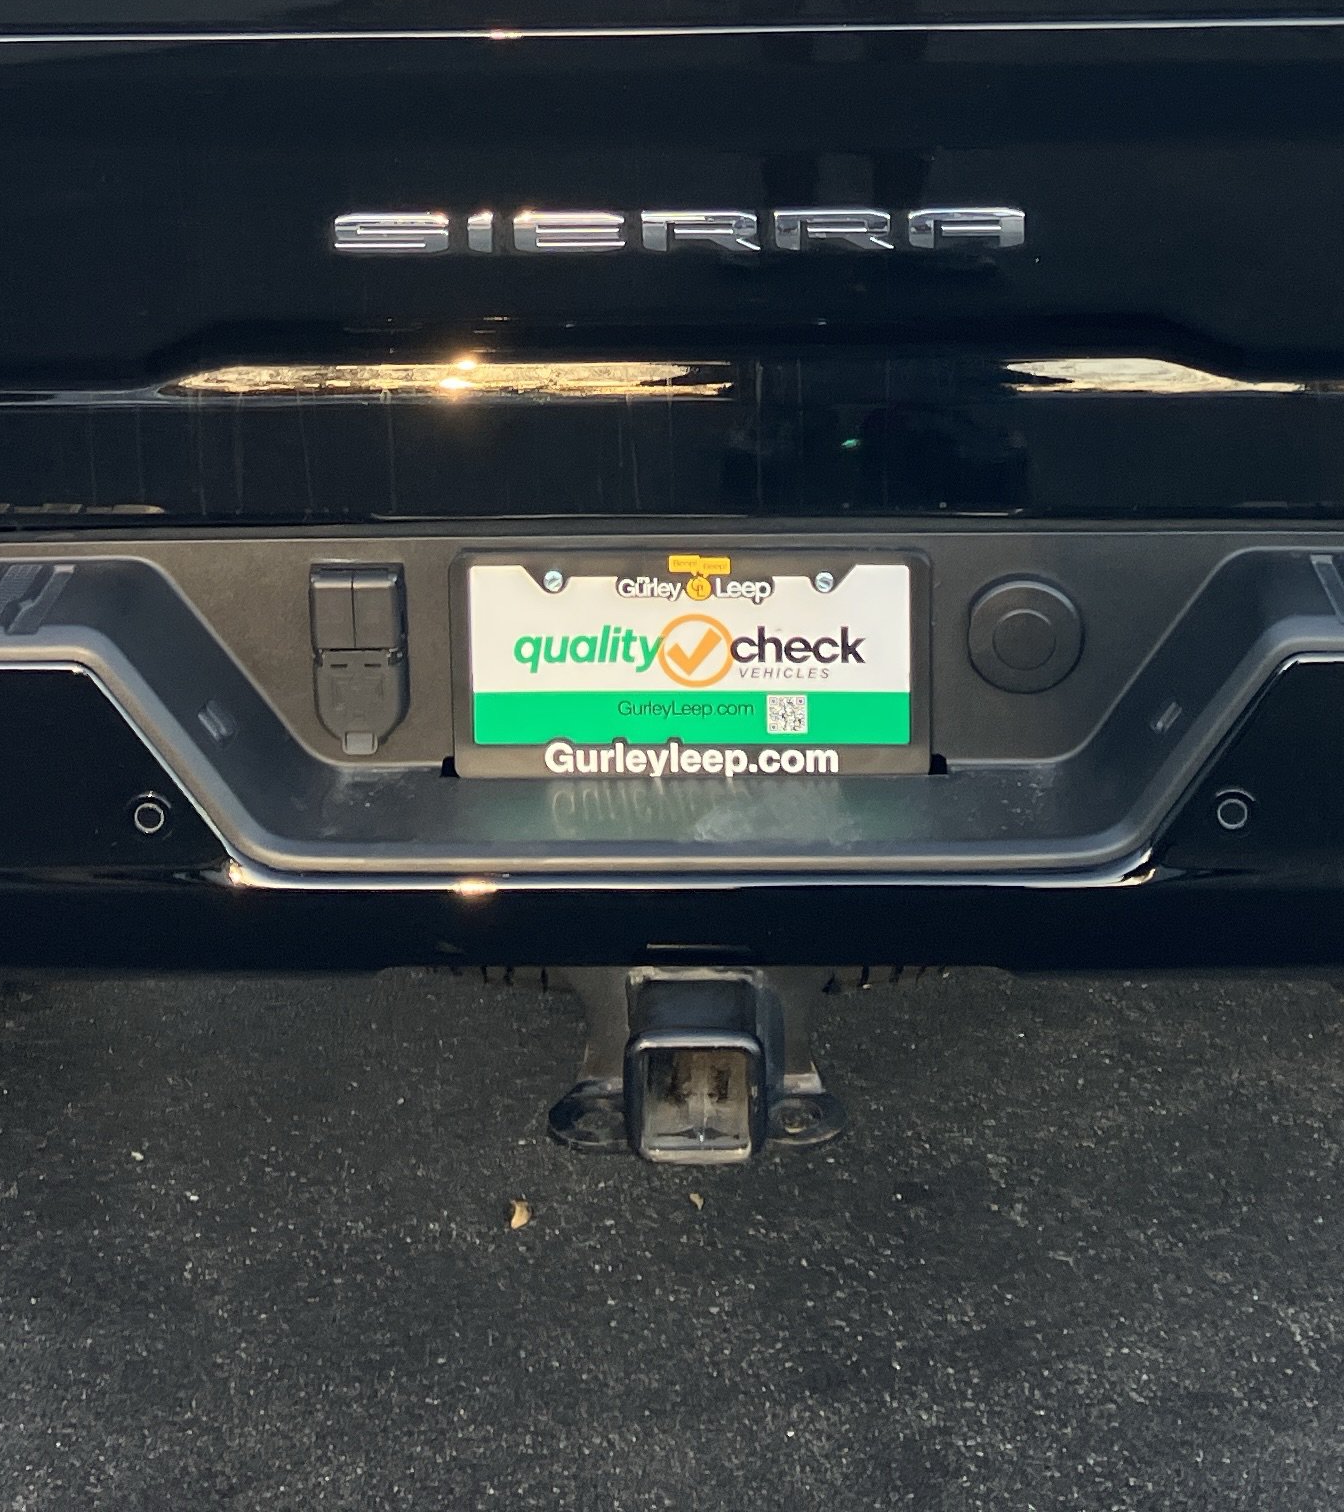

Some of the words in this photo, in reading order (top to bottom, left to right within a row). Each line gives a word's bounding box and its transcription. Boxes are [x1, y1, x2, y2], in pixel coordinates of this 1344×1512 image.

[332, 206, 1027, 254] SIERRA
[715, 578, 772, 604] Leep
[513, 625, 665, 673] quality
[730, 626, 866, 664] check
[739, 667, 830, 680] VEHICLES
[617, 700, 754, 719] GurleyLeep.com
[544, 741, 839, 778] Gurleyleep.com
